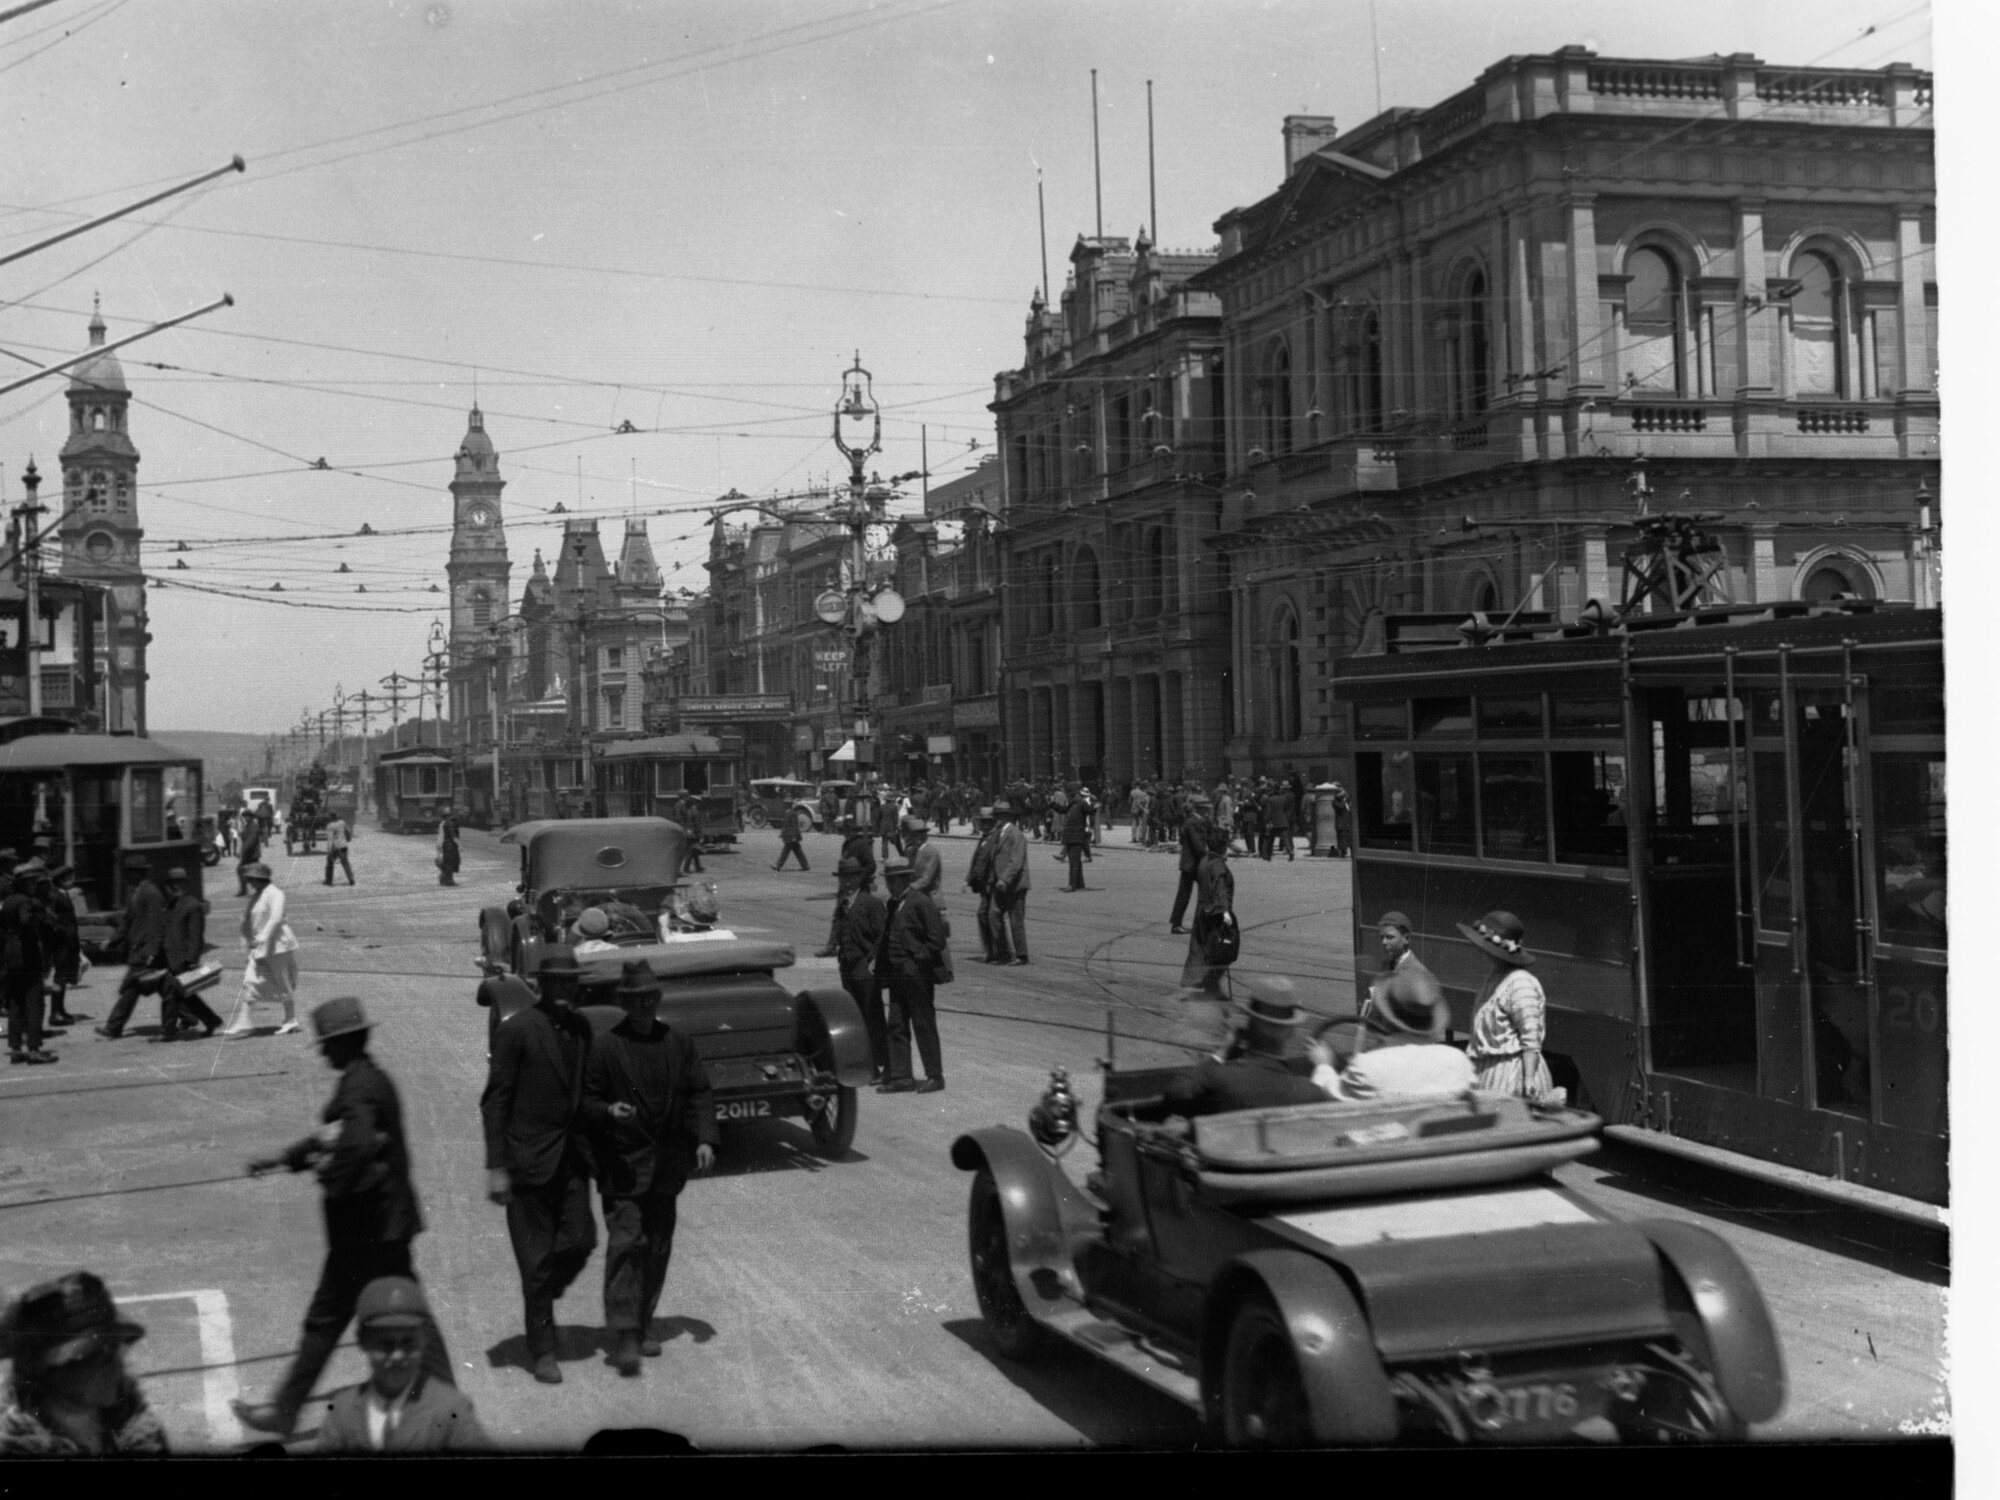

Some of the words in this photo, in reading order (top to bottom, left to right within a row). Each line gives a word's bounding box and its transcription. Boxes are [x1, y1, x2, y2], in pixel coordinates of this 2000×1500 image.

[815, 651, 847, 661] KEEP
[822, 662, 849, 672] LEFT
[715, 1100, 771, 1120] 20112
